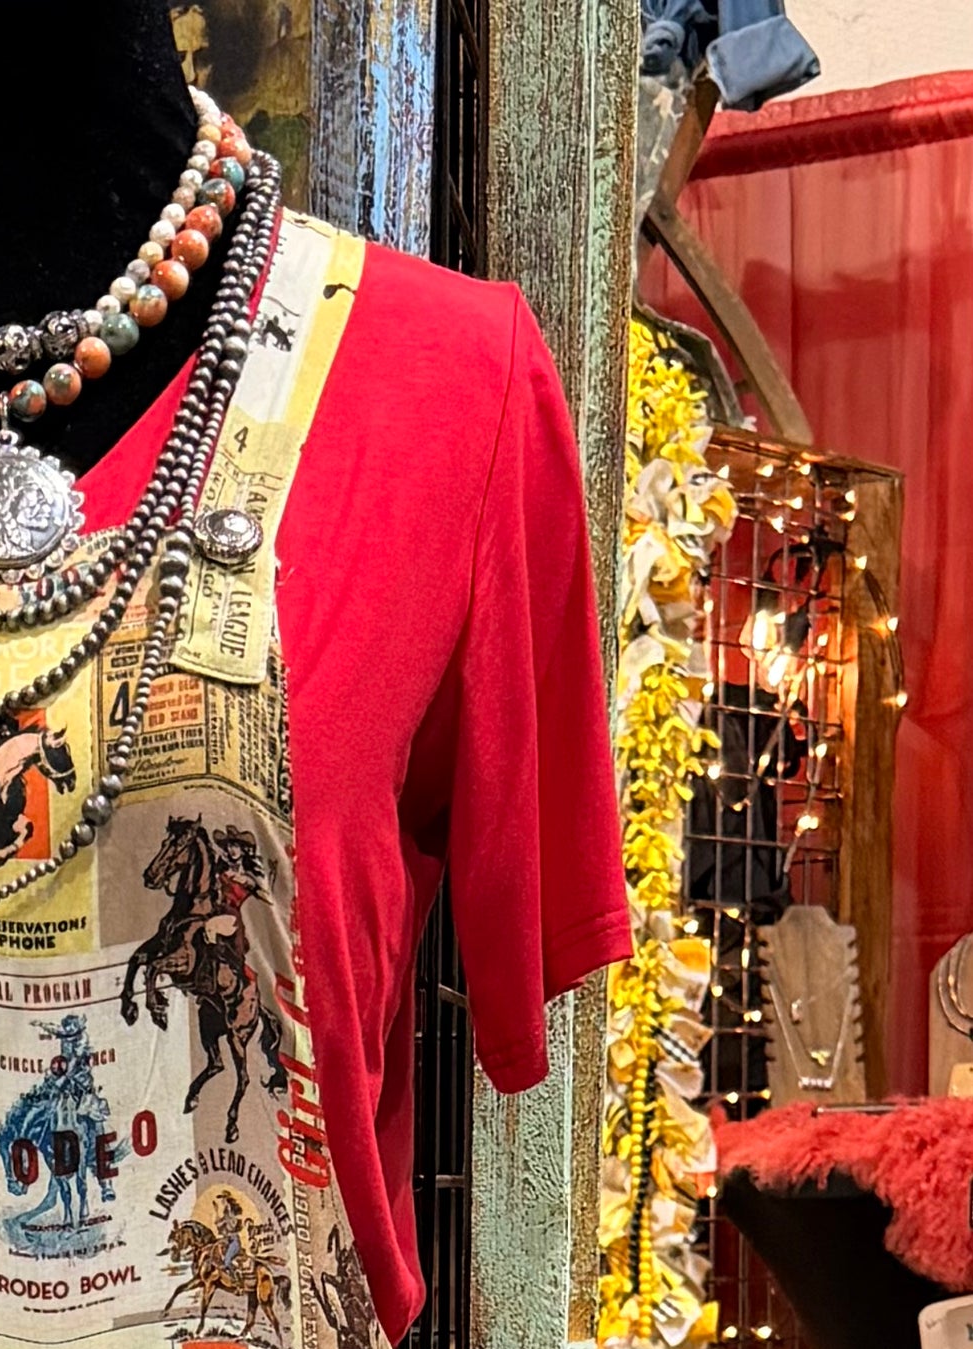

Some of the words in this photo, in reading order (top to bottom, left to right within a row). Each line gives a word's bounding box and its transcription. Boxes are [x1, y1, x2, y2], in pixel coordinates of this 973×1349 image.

[219, 590, 252, 659] LEAGUE
[23, 978, 92, 1002] PROGRAM
[0, 1054, 44, 1073] CIRCLE
[149, 1152, 199, 1222] LASHES
[208, 1147, 245, 1175] LEAD
[246, 1159, 294, 1237] CHANGES
[80, 1265, 142, 1295] BOWL
